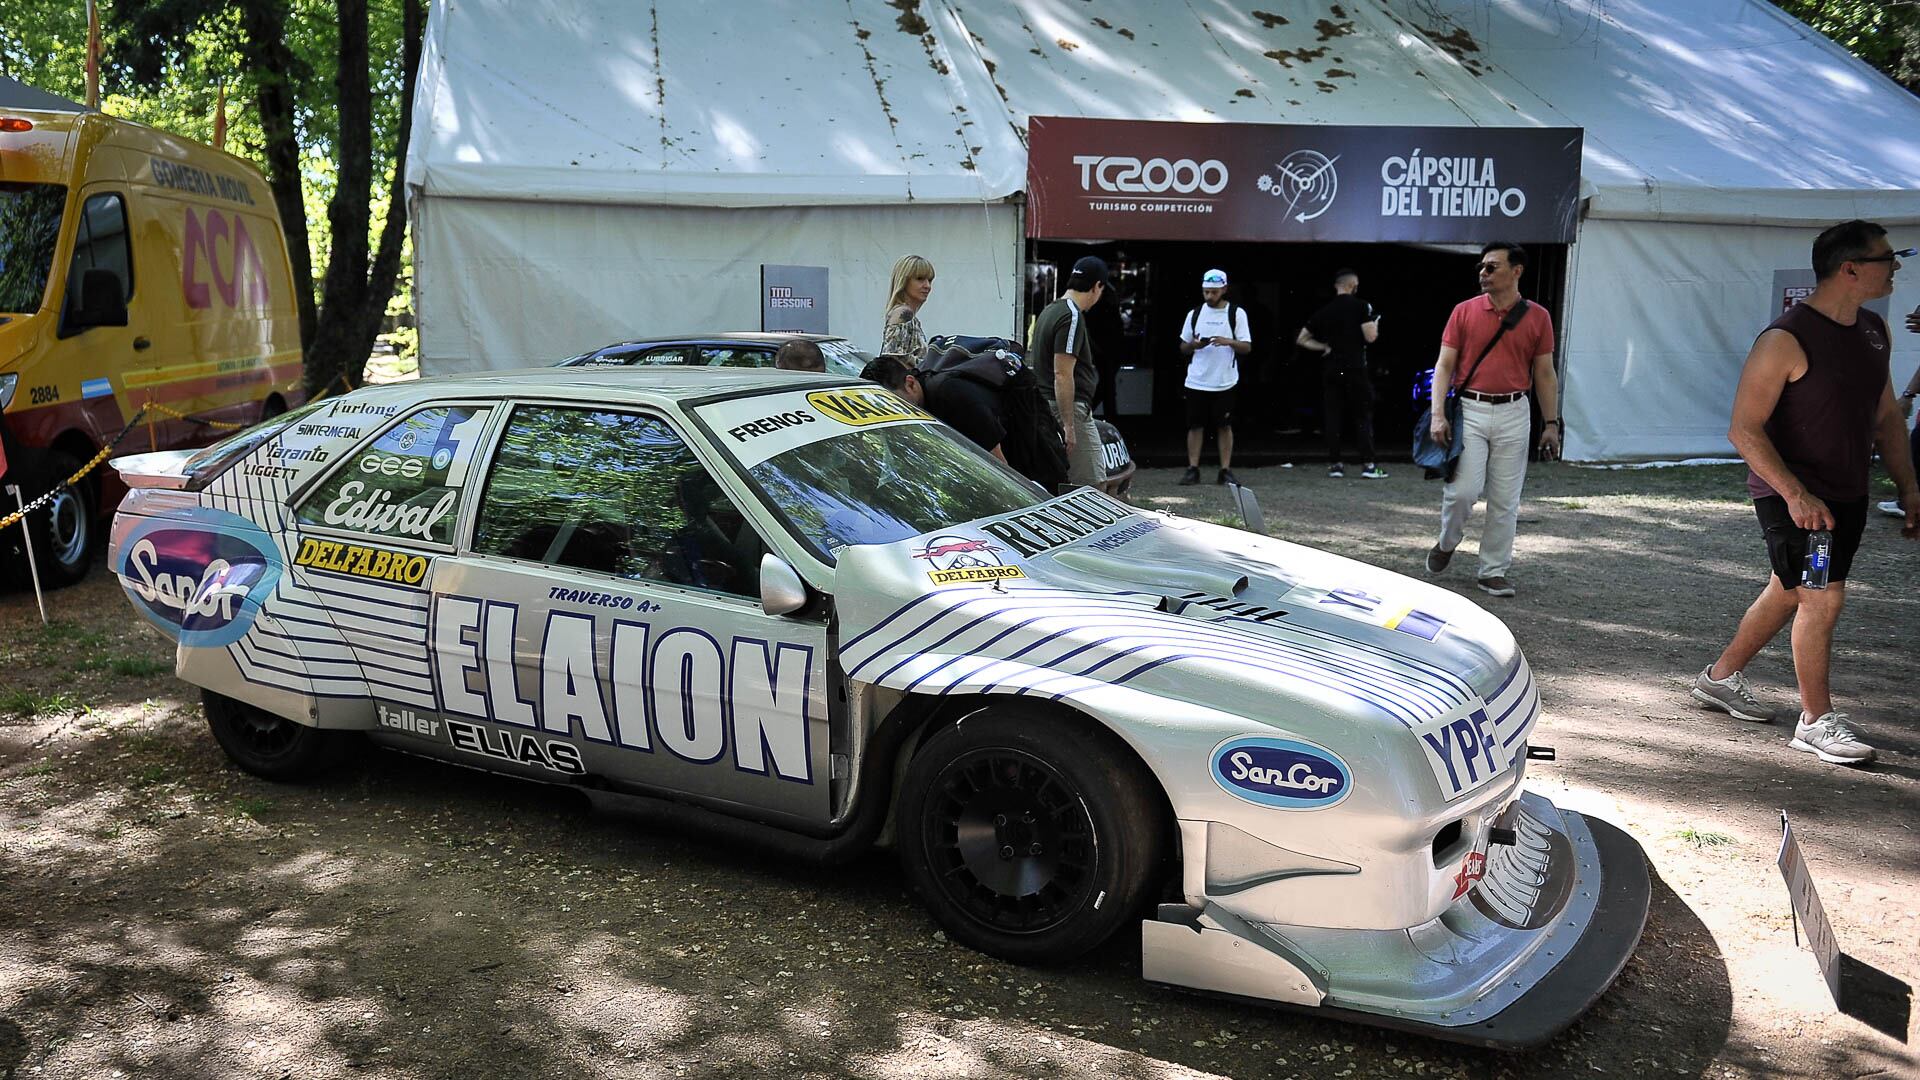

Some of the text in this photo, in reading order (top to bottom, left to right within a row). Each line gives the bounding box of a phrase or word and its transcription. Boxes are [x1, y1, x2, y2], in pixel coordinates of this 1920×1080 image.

[150, 157, 256, 206] GOMERIA MOVIL
[1073, 155, 1229, 194] TC2000
[1381, 148, 1496, 187] CÁPSULA
[1089, 202, 1213, 213] TURISMO COMPETICIÓN
[1381, 186, 1526, 218] DEL TIEMPO
[770, 287, 792, 298] TITO
[771, 298, 813, 308] BESSONE
[30, 385, 60, 404] 2884
[327, 399, 398, 419] Furlong
[296, 424, 362, 440] SINTERMETAL
[727, 410, 816, 443] FRENOS
[445, 409, 492, 488] 1
[243, 464, 300, 481] LIGGETT
[324, 480, 457, 541] Edival
[980, 490, 1135, 559] RENAULT
[296, 538, 427, 584] DELFABRO
[934, 567, 1020, 583] DELFABRO
[130, 538, 250, 621] SanCor
[548, 586, 663, 613] TRAVERSO A+
[434, 592, 814, 786] ELAION
[378, 704, 440, 737] taller
[445, 719, 588, 775] ELIAS
[1421, 708, 1497, 794] YPF
[1230, 751, 1338, 794] SanCor
